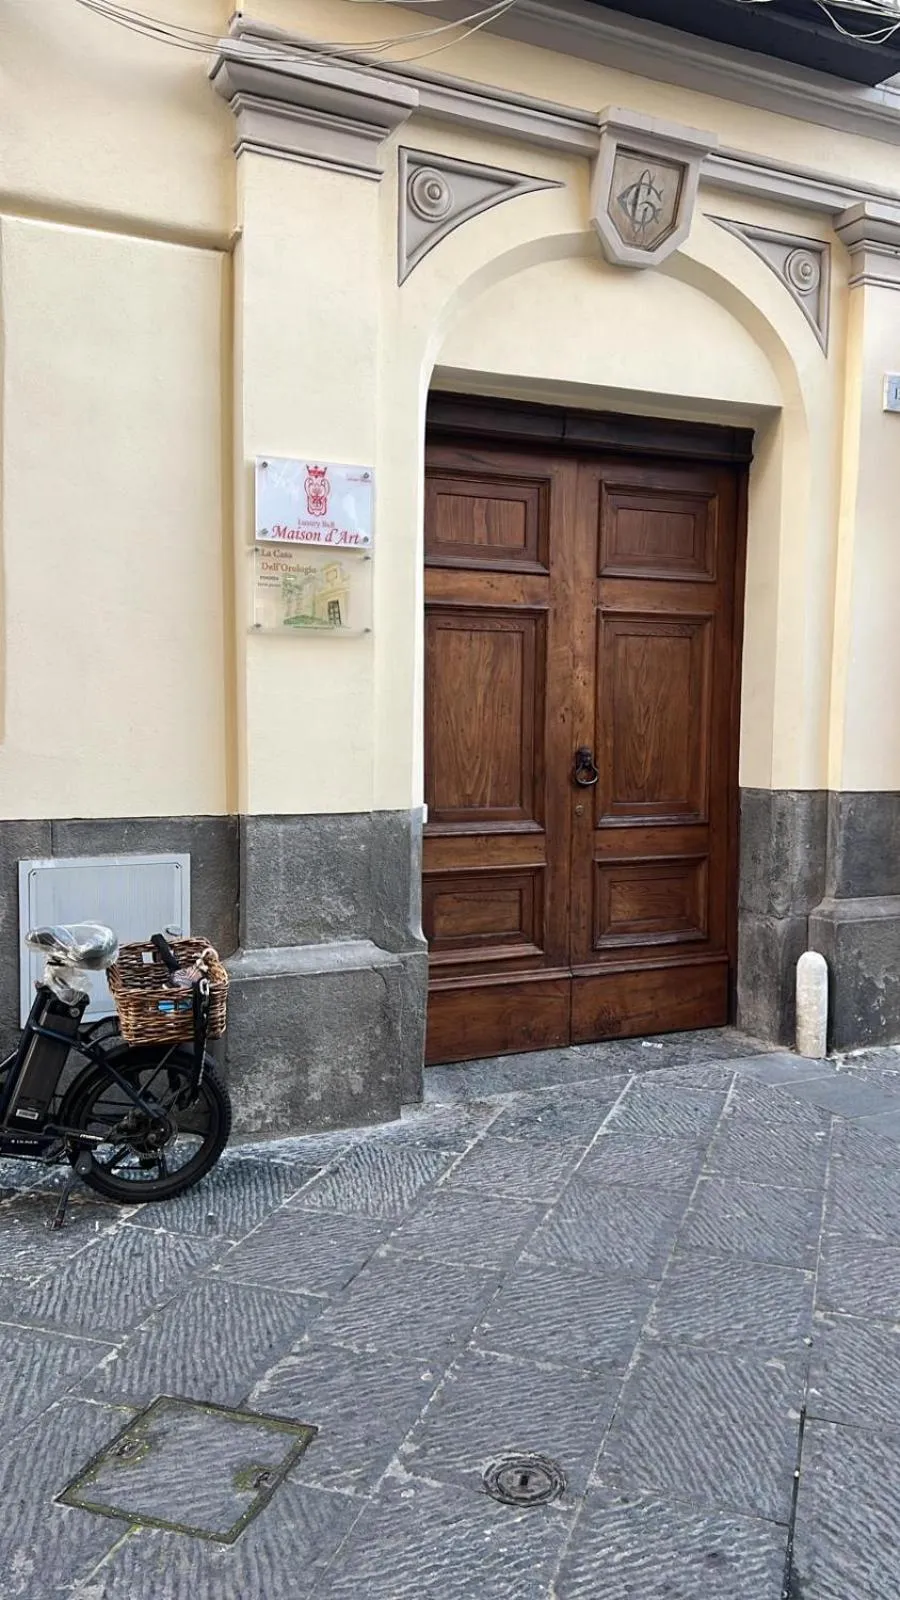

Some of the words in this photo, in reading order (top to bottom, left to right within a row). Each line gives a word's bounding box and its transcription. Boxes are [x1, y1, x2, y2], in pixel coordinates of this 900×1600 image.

[271, 525, 321, 540] Maison
[325, 528, 360, 545] d'Art
[261, 549, 272, 557] La
[273, 549, 293, 559] Casa
